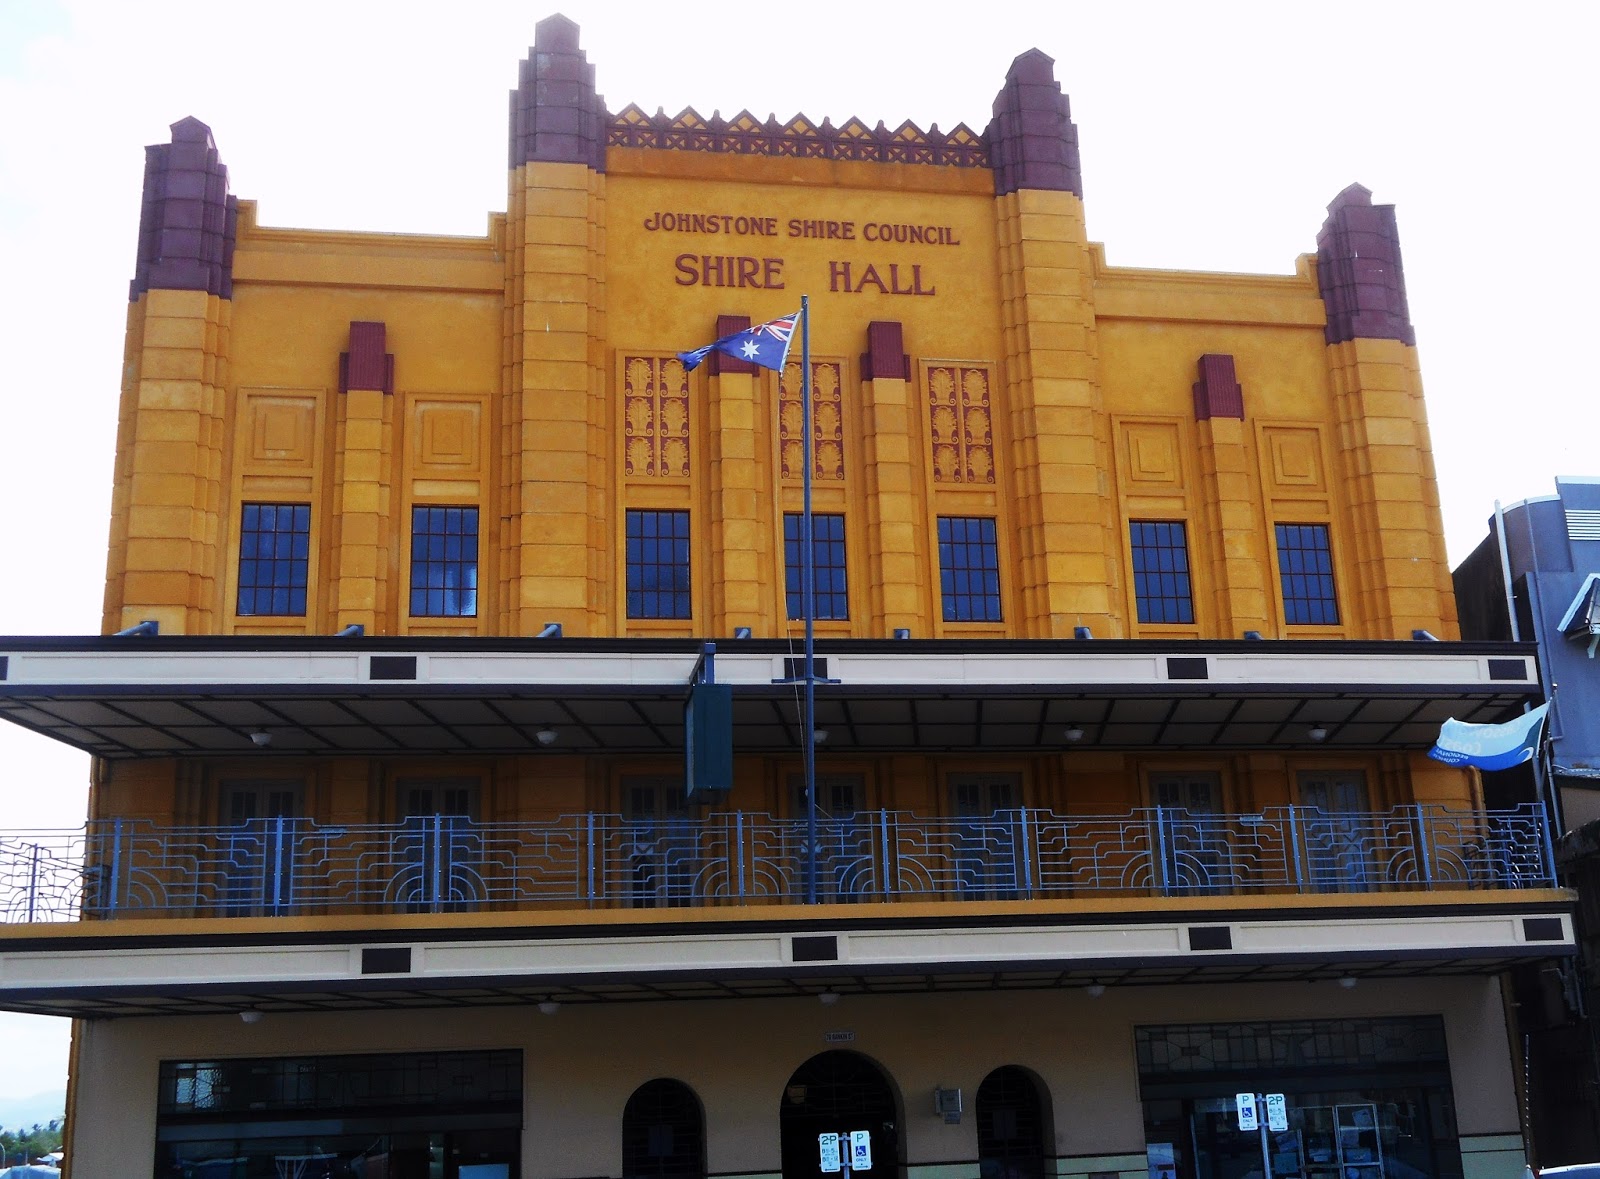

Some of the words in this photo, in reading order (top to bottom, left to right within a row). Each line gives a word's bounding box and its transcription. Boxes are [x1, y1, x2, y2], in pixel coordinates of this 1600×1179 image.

[644, 212, 778, 236] JOHNSTONE
[788, 219, 856, 239] SHIRE
[863, 222, 960, 245] COUNCIL
[674, 253, 785, 289] SHIRE
[828, 261, 936, 295] HALL
[1242, 1095, 1250, 1104] P
[1268, 1095, 1283, 1105] 2P
[821, 1135, 837, 1145] 2P
[856, 1133, 864, 1143] P
